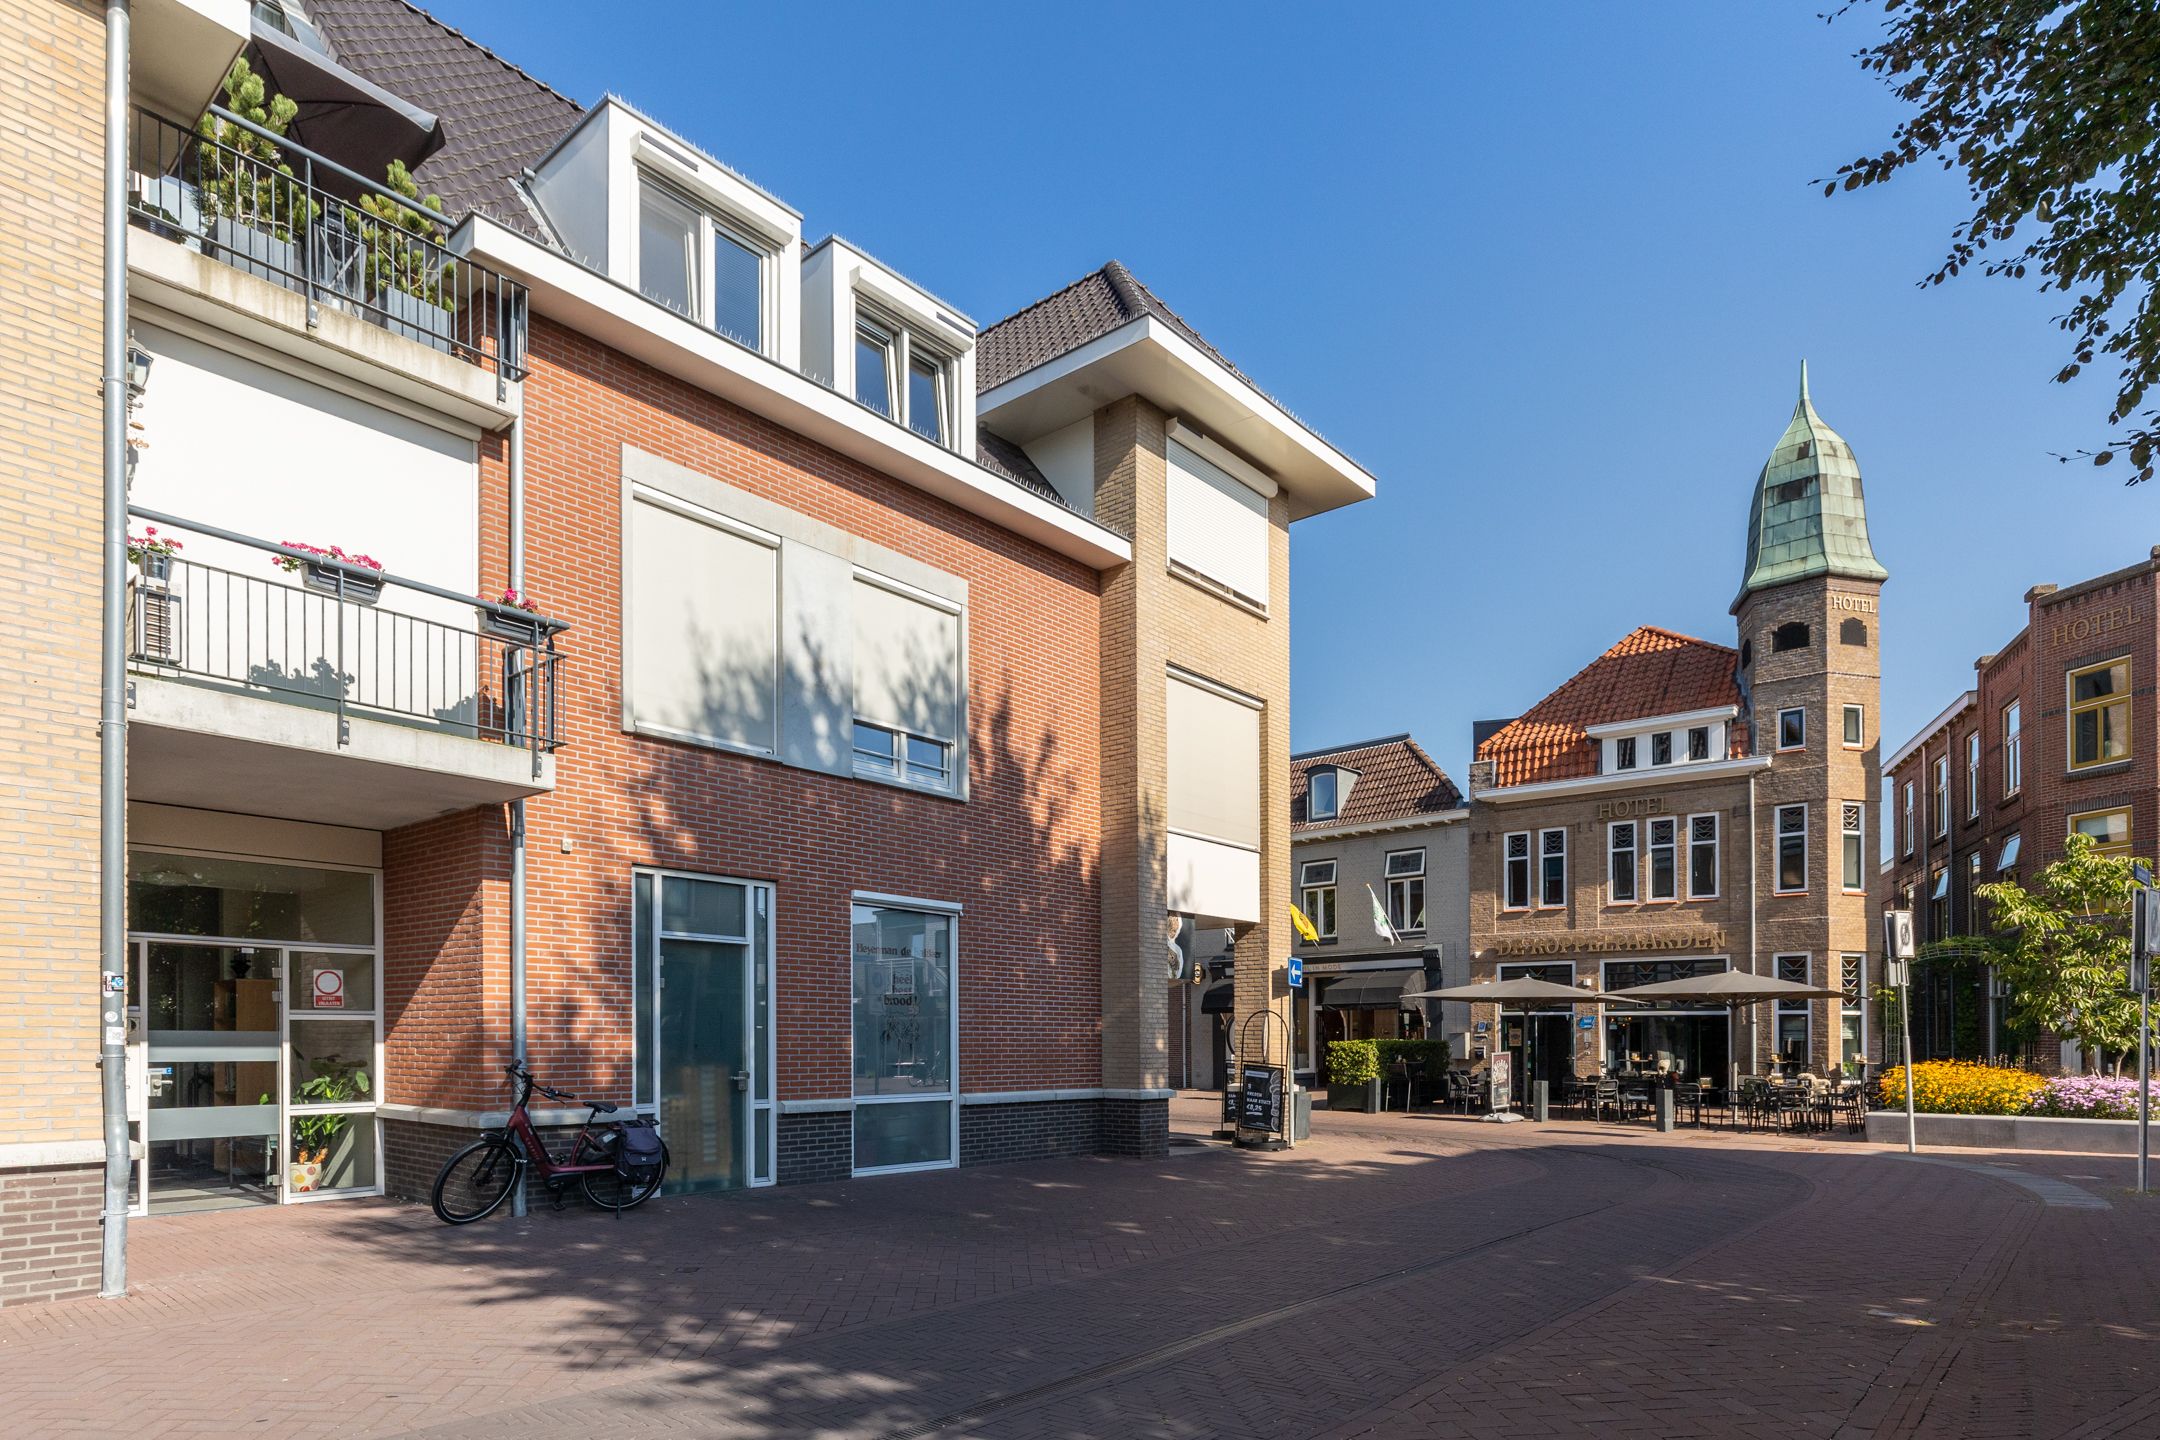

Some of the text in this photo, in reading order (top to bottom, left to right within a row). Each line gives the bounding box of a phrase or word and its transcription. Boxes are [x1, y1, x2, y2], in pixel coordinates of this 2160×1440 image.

[1831, 595, 1876, 613] HOTEL
[2052, 605, 2141, 646] HOTEL
[1598, 796, 1671, 819] HOTEL
[901, 946, 911, 956] de
[1497, 929, 1727, 956] DE KOPPELPAARDEN
